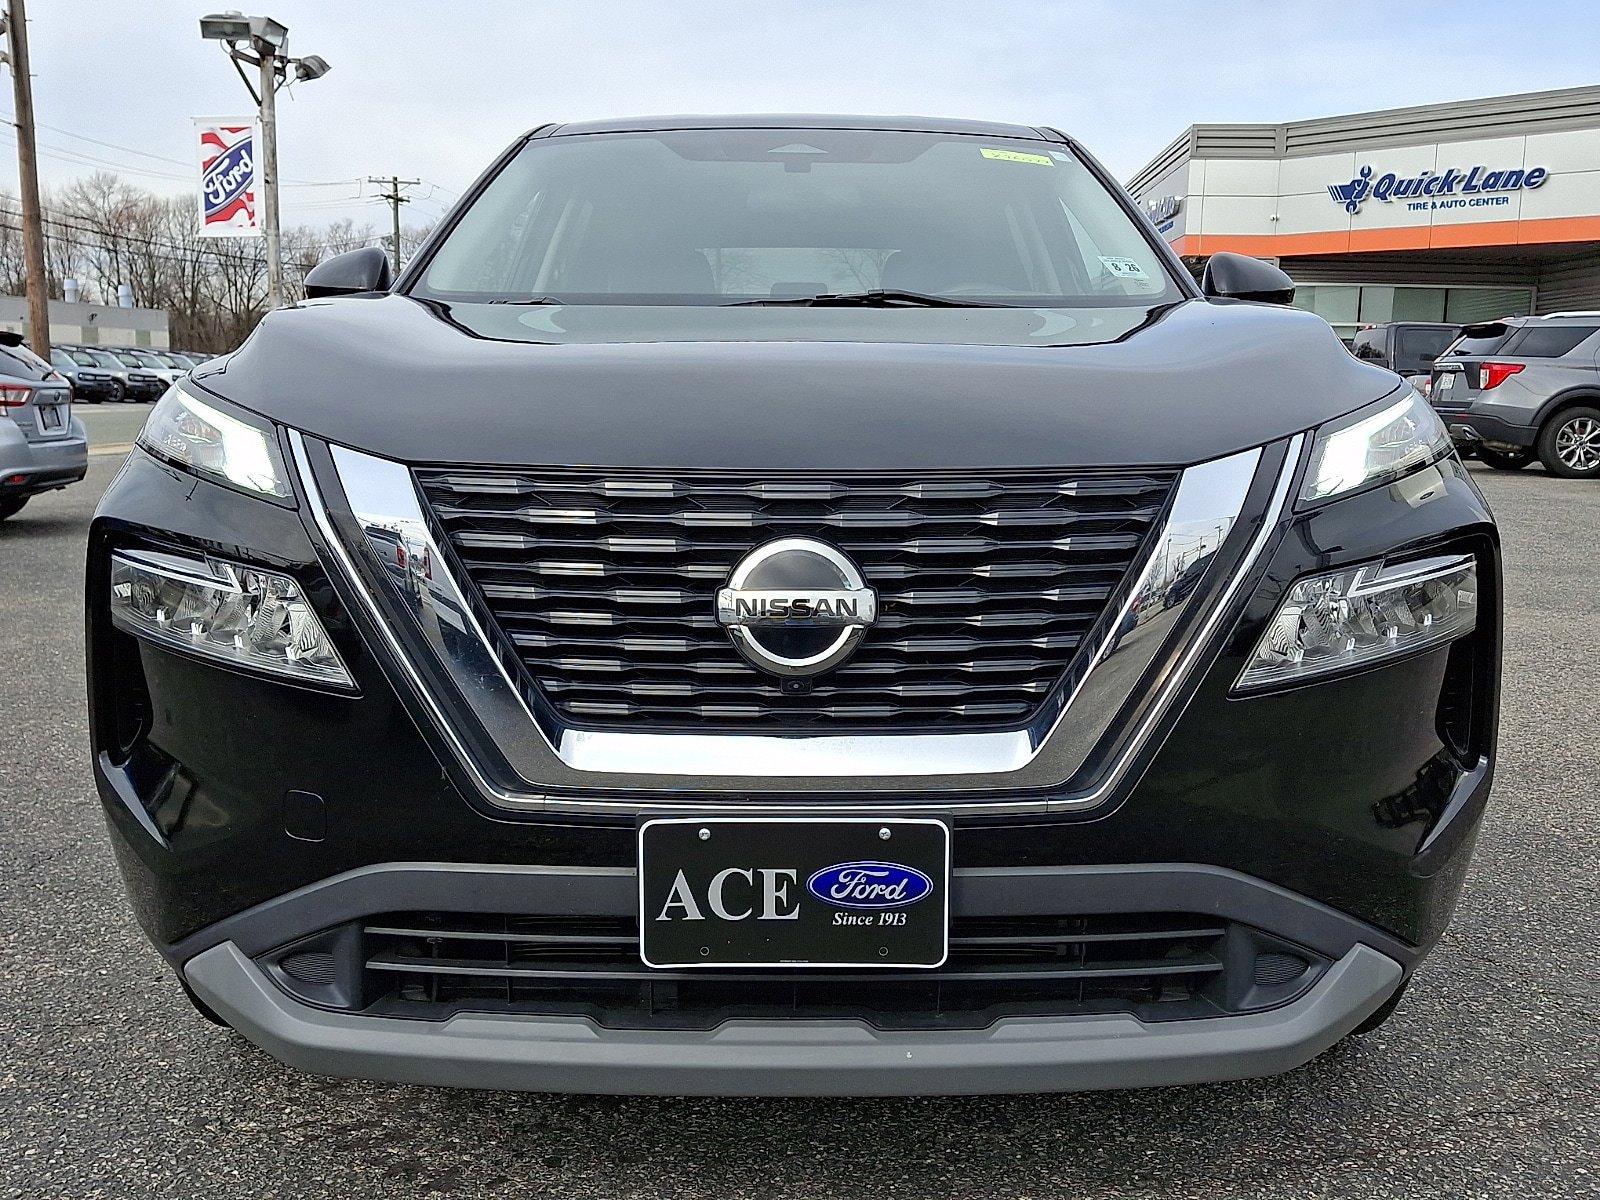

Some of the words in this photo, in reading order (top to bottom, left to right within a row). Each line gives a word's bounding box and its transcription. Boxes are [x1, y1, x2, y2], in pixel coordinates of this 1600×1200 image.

[203, 149, 253, 205] Ford
[1373, 168, 1460, 201] Quick
[1462, 166, 1547, 193] Lane
[1407, 202, 1429, 212] TIRE
[1430, 202, 1438, 210] &
[1439, 200, 1466, 210] AUTO
[1468, 197, 1510, 208] CENTER
[1111, 262, 1122, 272] 8
[1124, 263, 1141, 273] 26
[735, 598, 858, 618] NISSAN
[655, 867, 801, 921] ACE
[830, 869, 910, 900] Ford
[832, 912, 873, 926] Since
[878, 912, 907, 926] 1913
